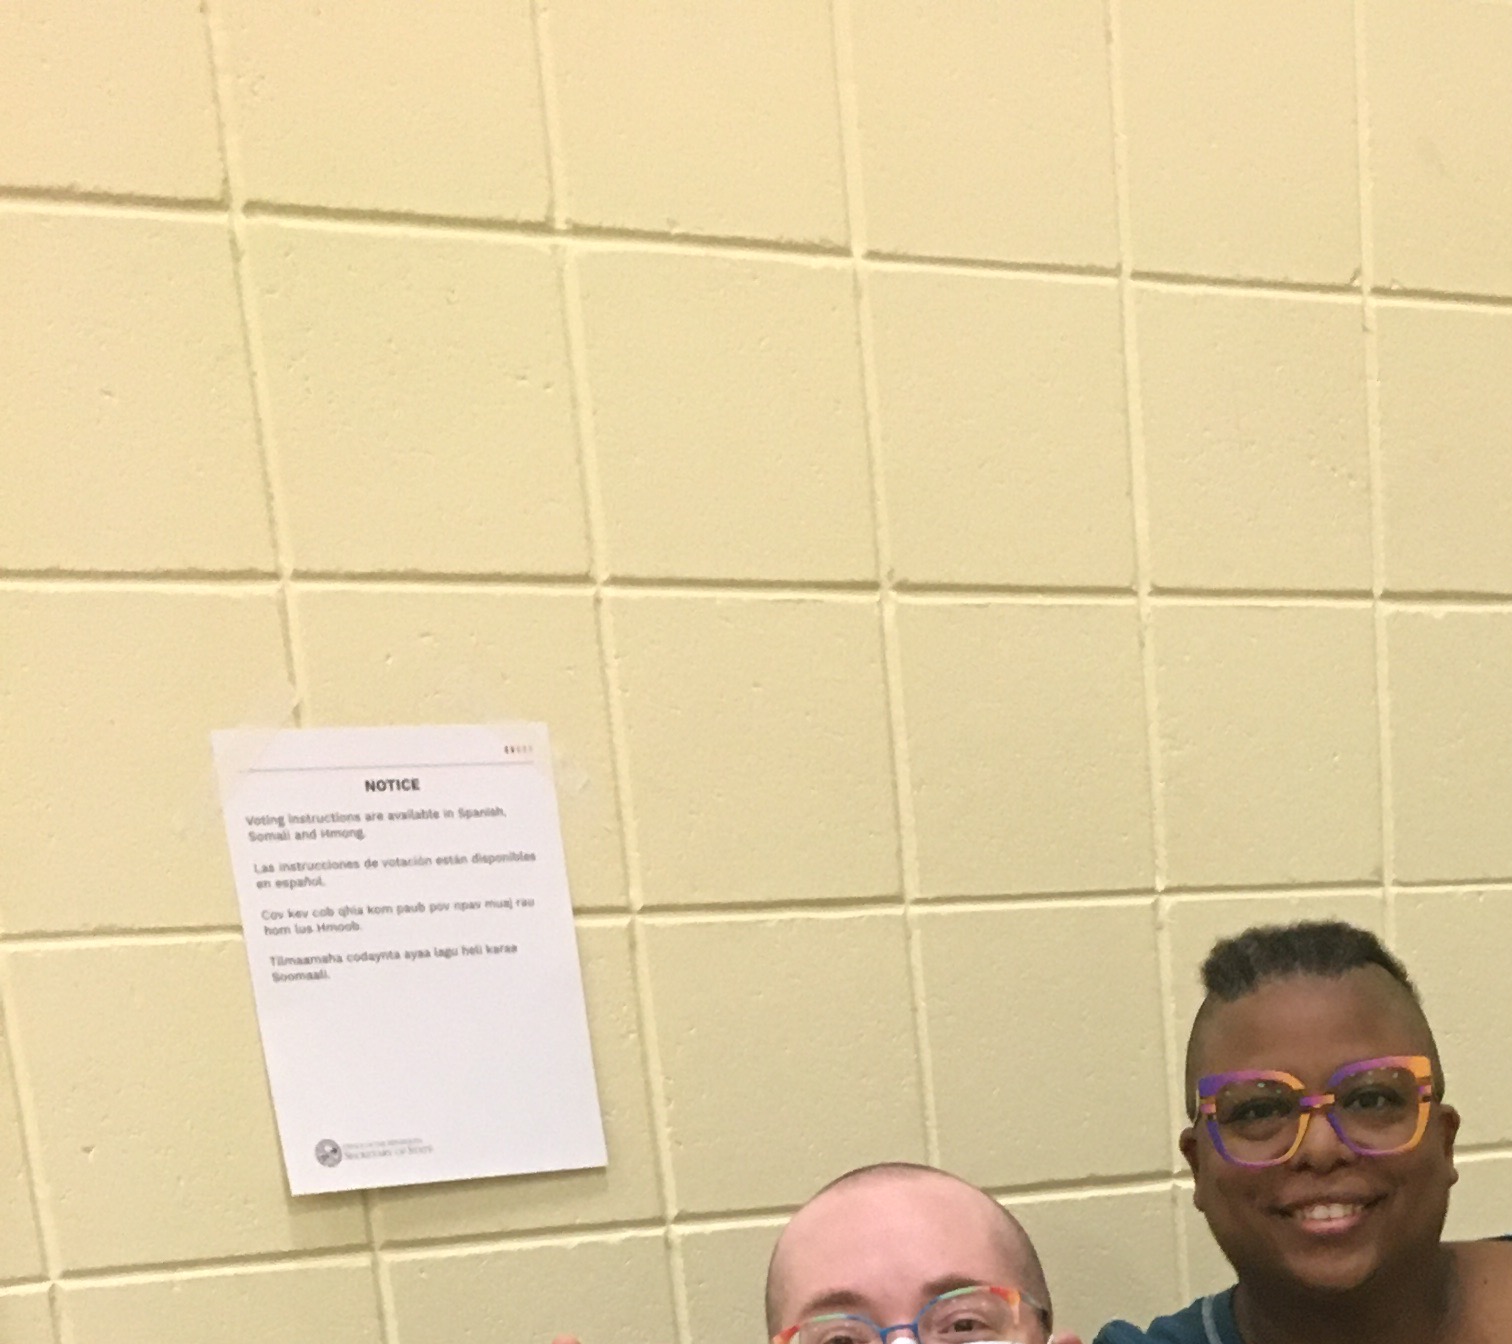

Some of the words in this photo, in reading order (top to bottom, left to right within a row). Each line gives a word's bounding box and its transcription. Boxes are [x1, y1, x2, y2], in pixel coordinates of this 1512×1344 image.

[365, 778, 420, 793] NOTICE
[246, 815, 285, 828] Voting
[288, 812, 361, 825] instructions
[365, 812, 384, 822] are
[388, 809, 440, 821] available
[443, 809, 454, 818] in
[248, 829, 291, 842] Somali
[294, 829, 317, 840] and
[253, 863, 275, 874] Las
[279, 859, 360, 872] instrucciones
[364, 858, 379, 869] de
[382, 855, 432, 868] votación
[435, 853, 468, 866] están
[472, 850, 537, 865] disponibles
[256, 879, 272, 889] en
[261, 909, 284, 921] Cov
[287, 908, 309, 919] kev
[312, 906, 335, 918] cob
[338, 905, 364, 918] qhia
[367, 904, 393, 914] kom
[396, 902, 426, 915] paub
[429, 902, 450, 914] pov
[485, 897, 513, 910] muaj
[516, 898, 535, 908] rau
[264, 924, 291, 936] hom
[434, 947, 459, 959] lagu
[485, 944, 518, 954] karaa
